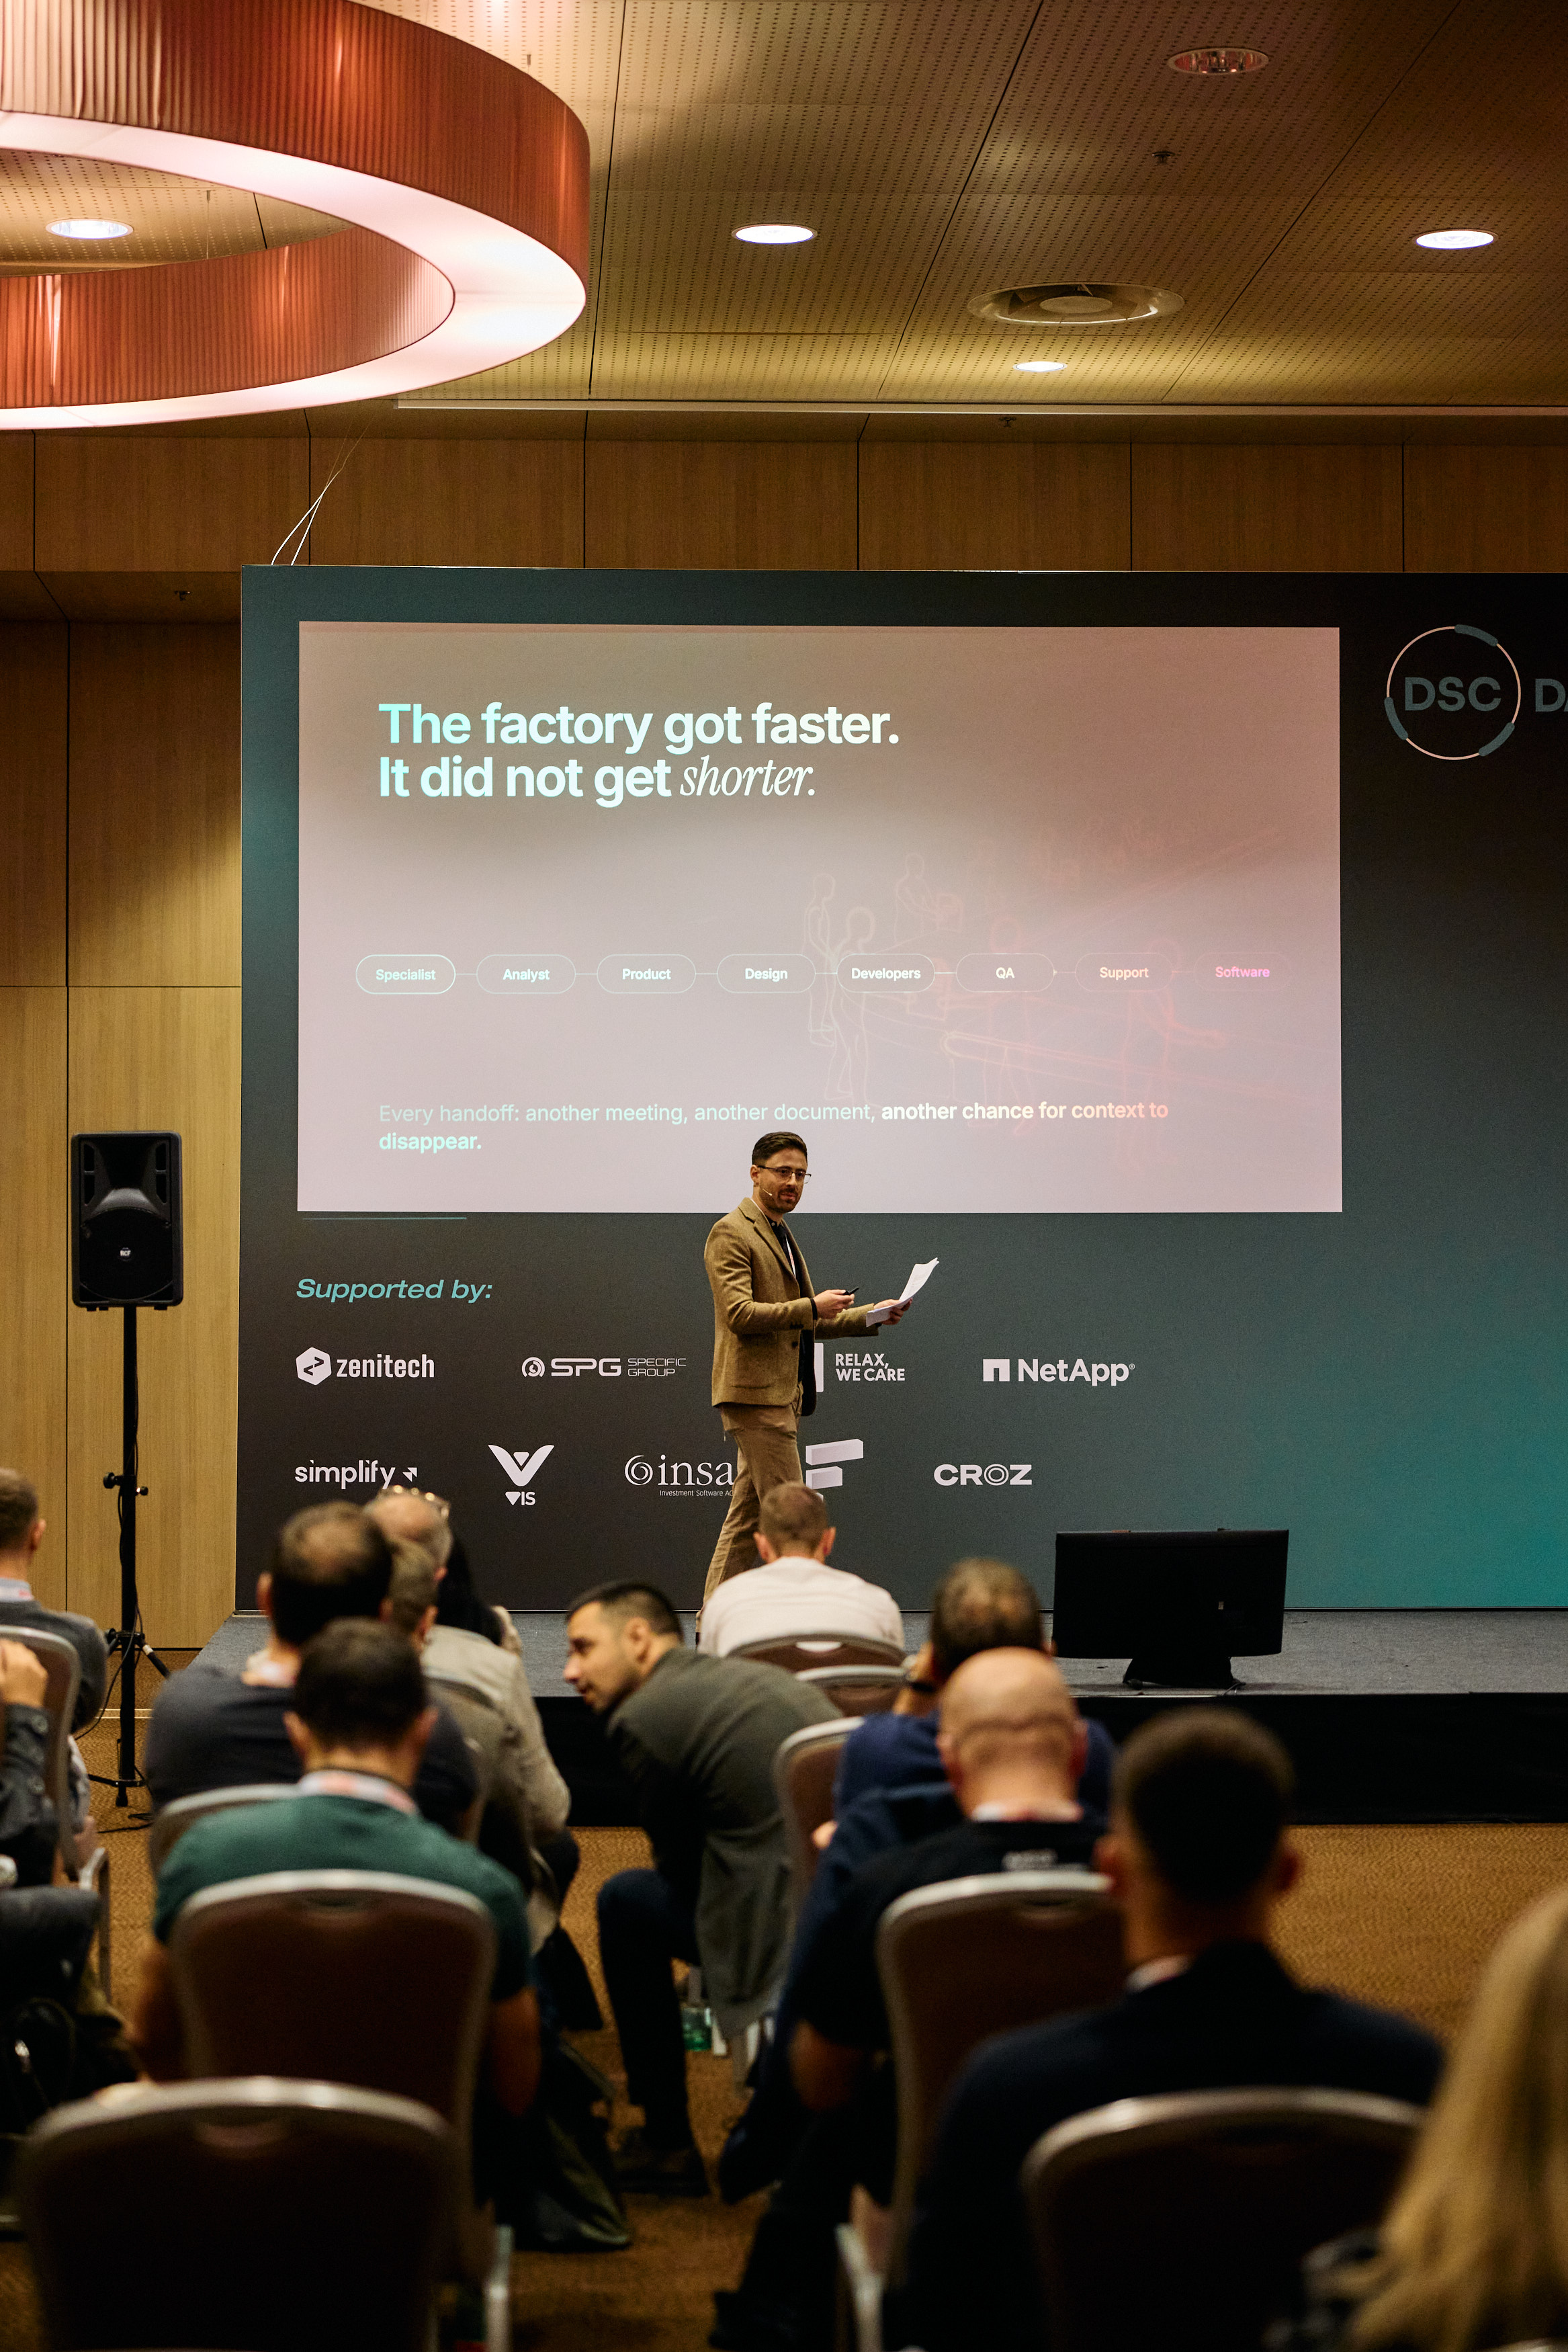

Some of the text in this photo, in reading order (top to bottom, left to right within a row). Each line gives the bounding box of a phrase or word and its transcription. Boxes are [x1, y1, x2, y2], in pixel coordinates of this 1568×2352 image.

[1405, 677, 1568, 712] DSC D
[379, 702, 900, 755] The factory got faster.
[380, 755, 816, 808] It did not get shorter.
[376, 968, 436, 982] Specialist
[503, 968, 550, 983] Analyst
[622, 968, 671, 980] Product
[744, 967, 788, 982] Design
[851, 967, 921, 982] Developers
[996, 966, 1015, 980] QA
[1099, 966, 1149, 981] Support
[1215, 966, 1270, 978] Software
[380, 1101, 1169, 1126] Every handoff: another meeting, another document, another chance for context to
[379, 1132, 482, 1154] disappear.
[296, 1278, 492, 1304] Supported by:
[336, 1354, 435, 1378] zenitech
[551, 1358, 621, 1377] SPG
[627, 1358, 687, 1367] SPECIFIC
[835, 1353, 889, 1369] RELAX,
[627, 1368, 675, 1377] GROUP
[836, 1368, 906, 1382] WE CARE
[294, 1460, 396, 1490] simplify
[933, 1464, 1033, 1486] CROZ
